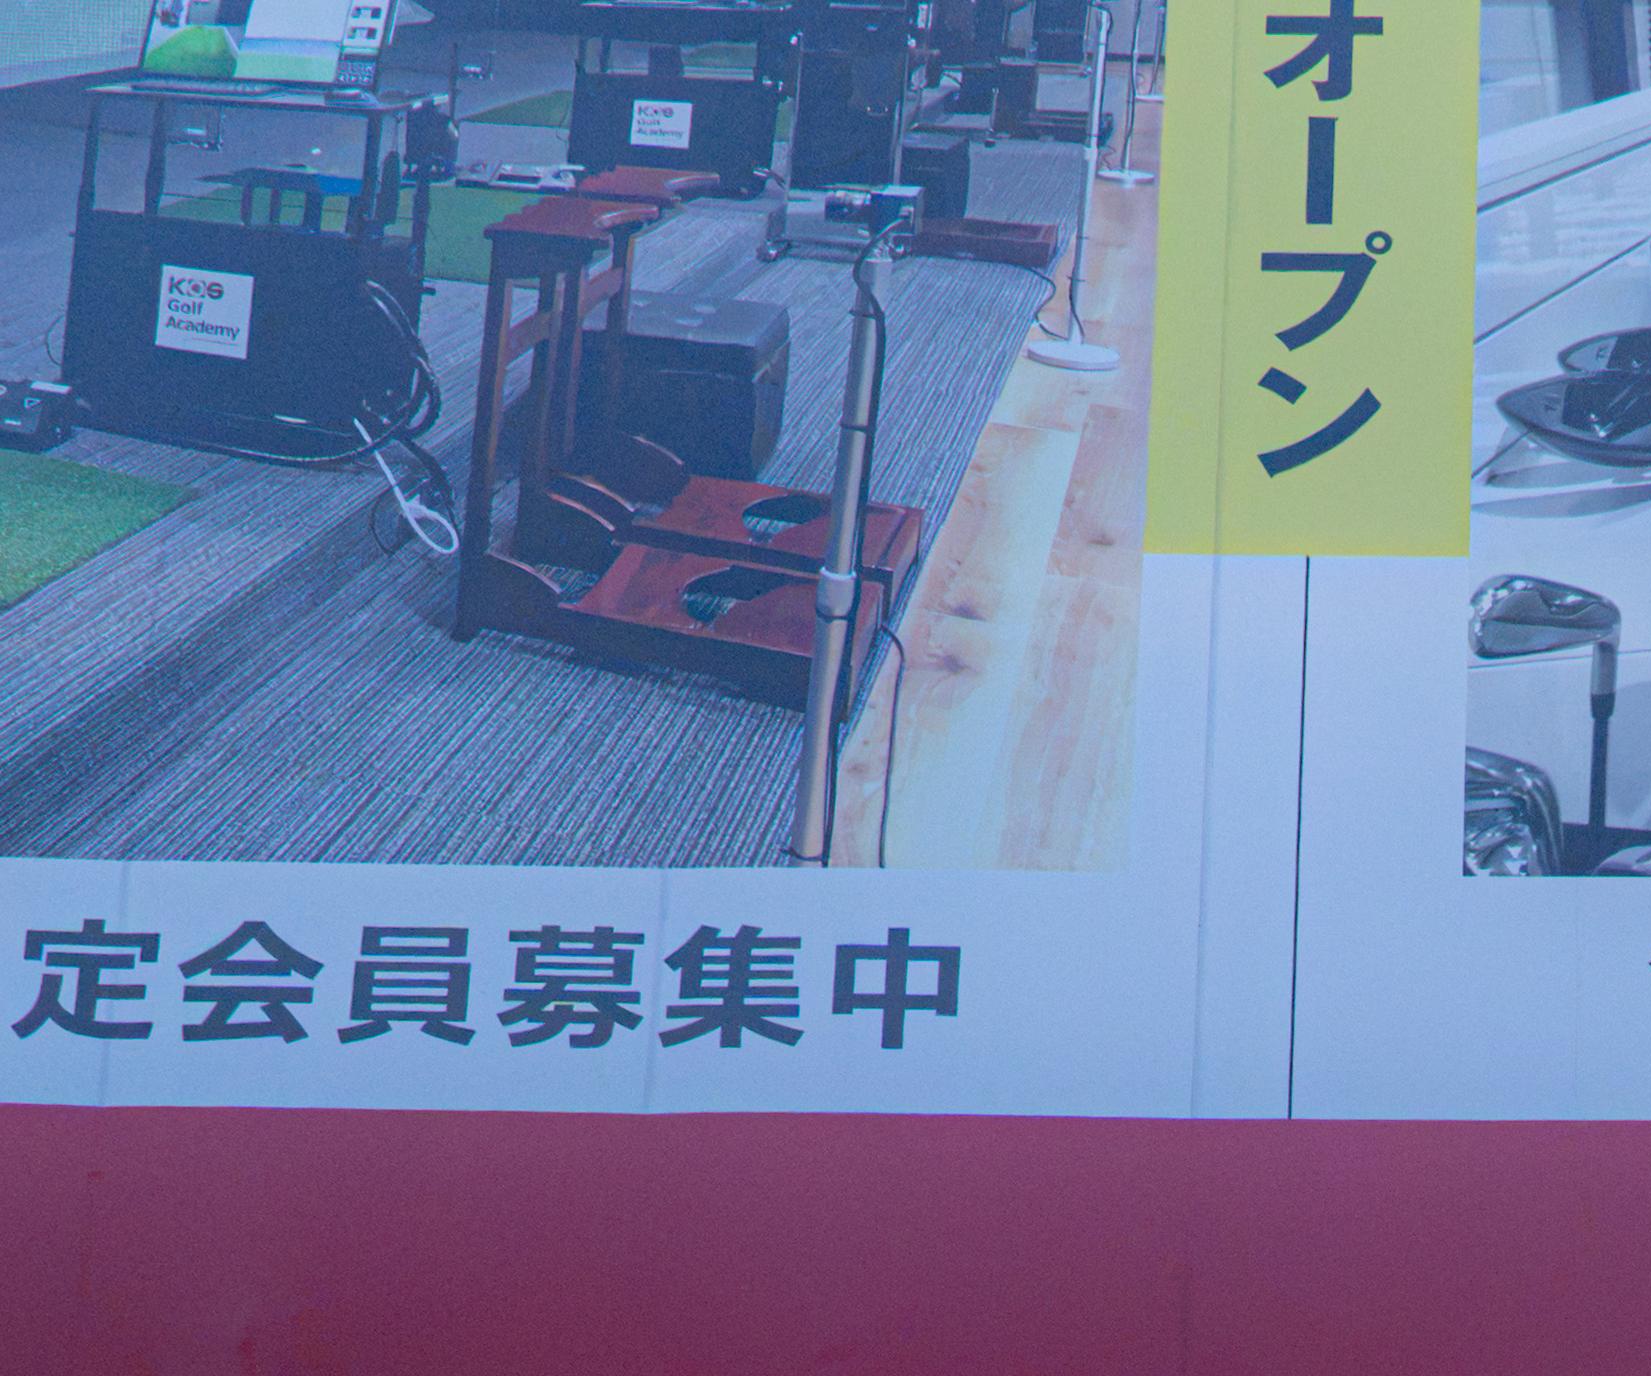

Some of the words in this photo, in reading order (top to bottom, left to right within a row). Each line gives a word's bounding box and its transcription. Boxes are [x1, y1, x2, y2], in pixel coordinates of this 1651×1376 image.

[1256, 0, 1392, 477] オープン
[165, 316, 240, 341] Academy
[168, 299, 203, 315] Golf
[11, 919, 961, 1050] 定会員募集中
